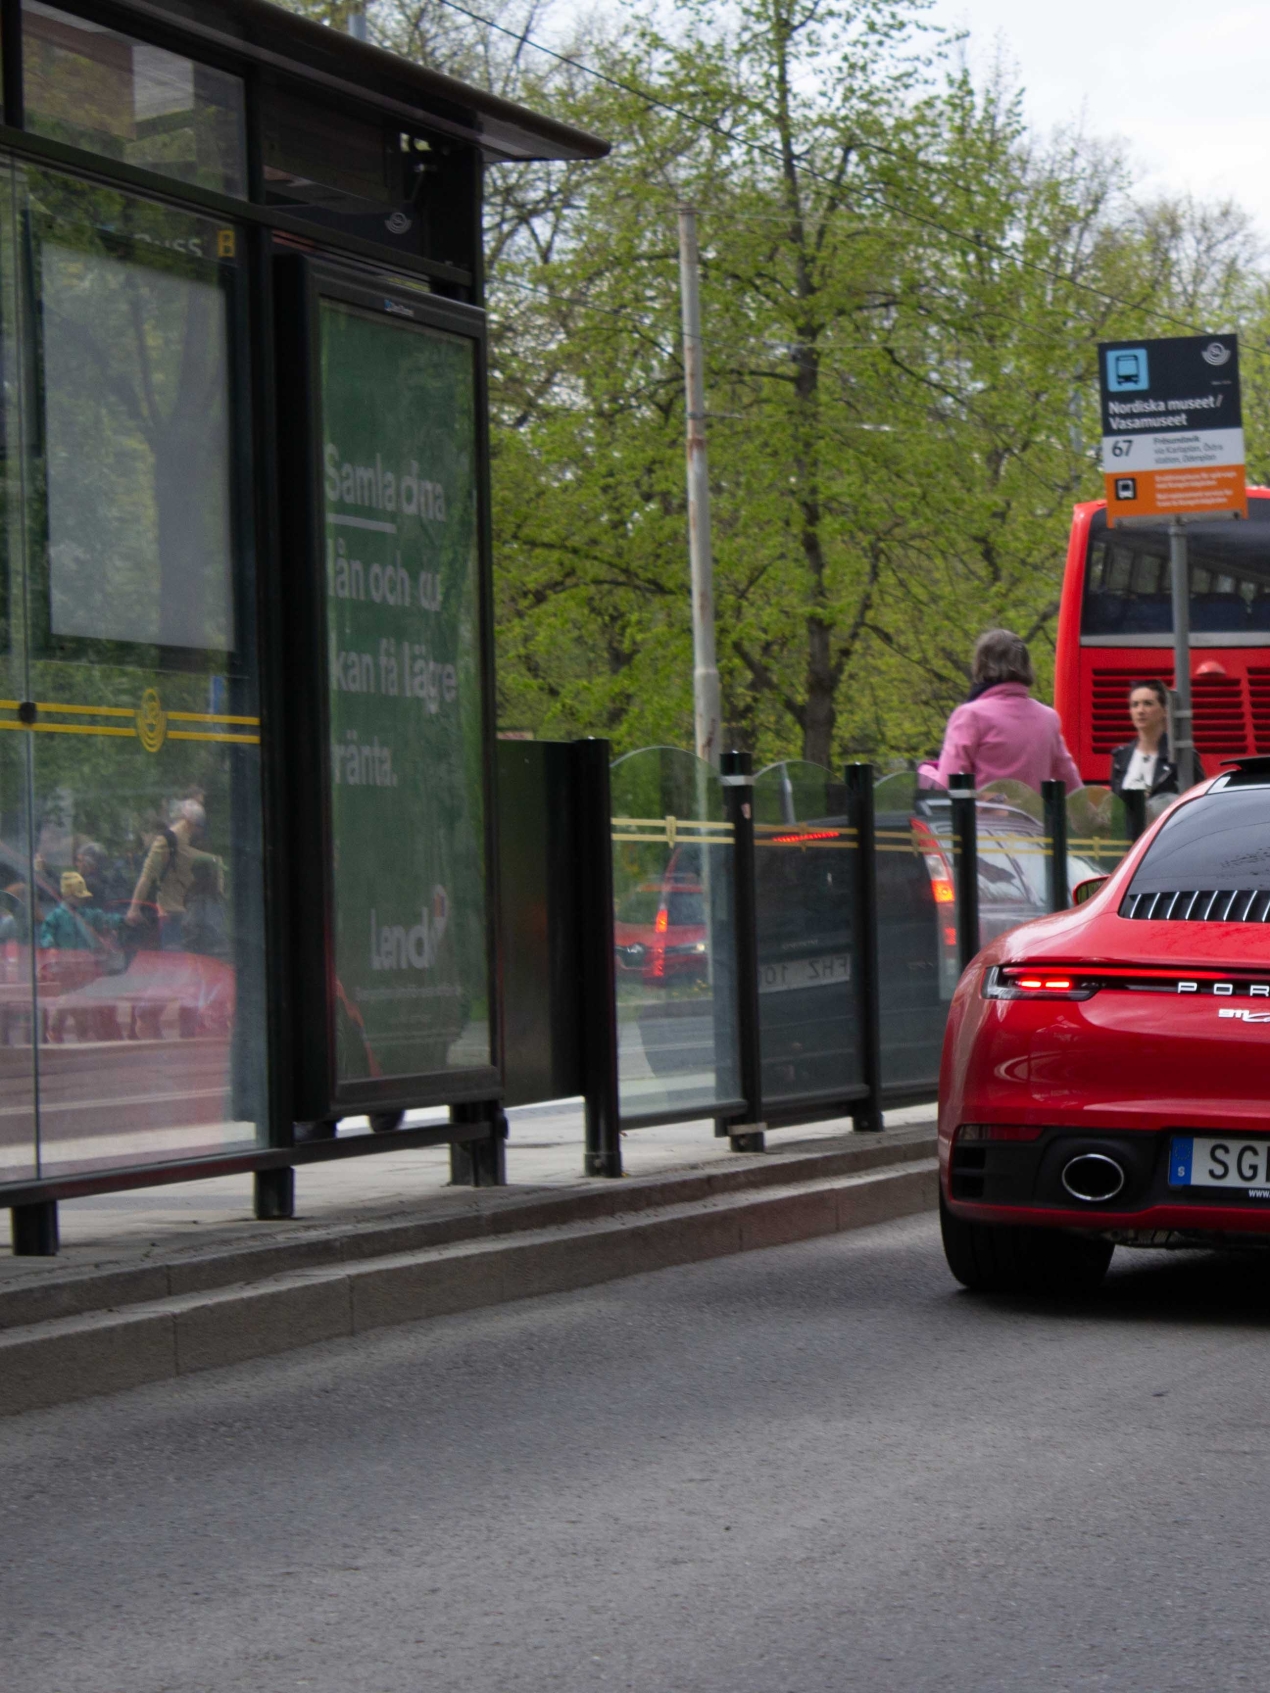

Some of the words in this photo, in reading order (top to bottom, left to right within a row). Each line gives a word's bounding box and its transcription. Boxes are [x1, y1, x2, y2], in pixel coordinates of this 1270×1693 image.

[1108, 398, 1166, 414] Nordiska
[1108, 413, 1188, 430] Vasamuseet
[1112, 439, 1134, 458] 67
[324, 443, 397, 513] Samla
[369, 549, 412, 607] och
